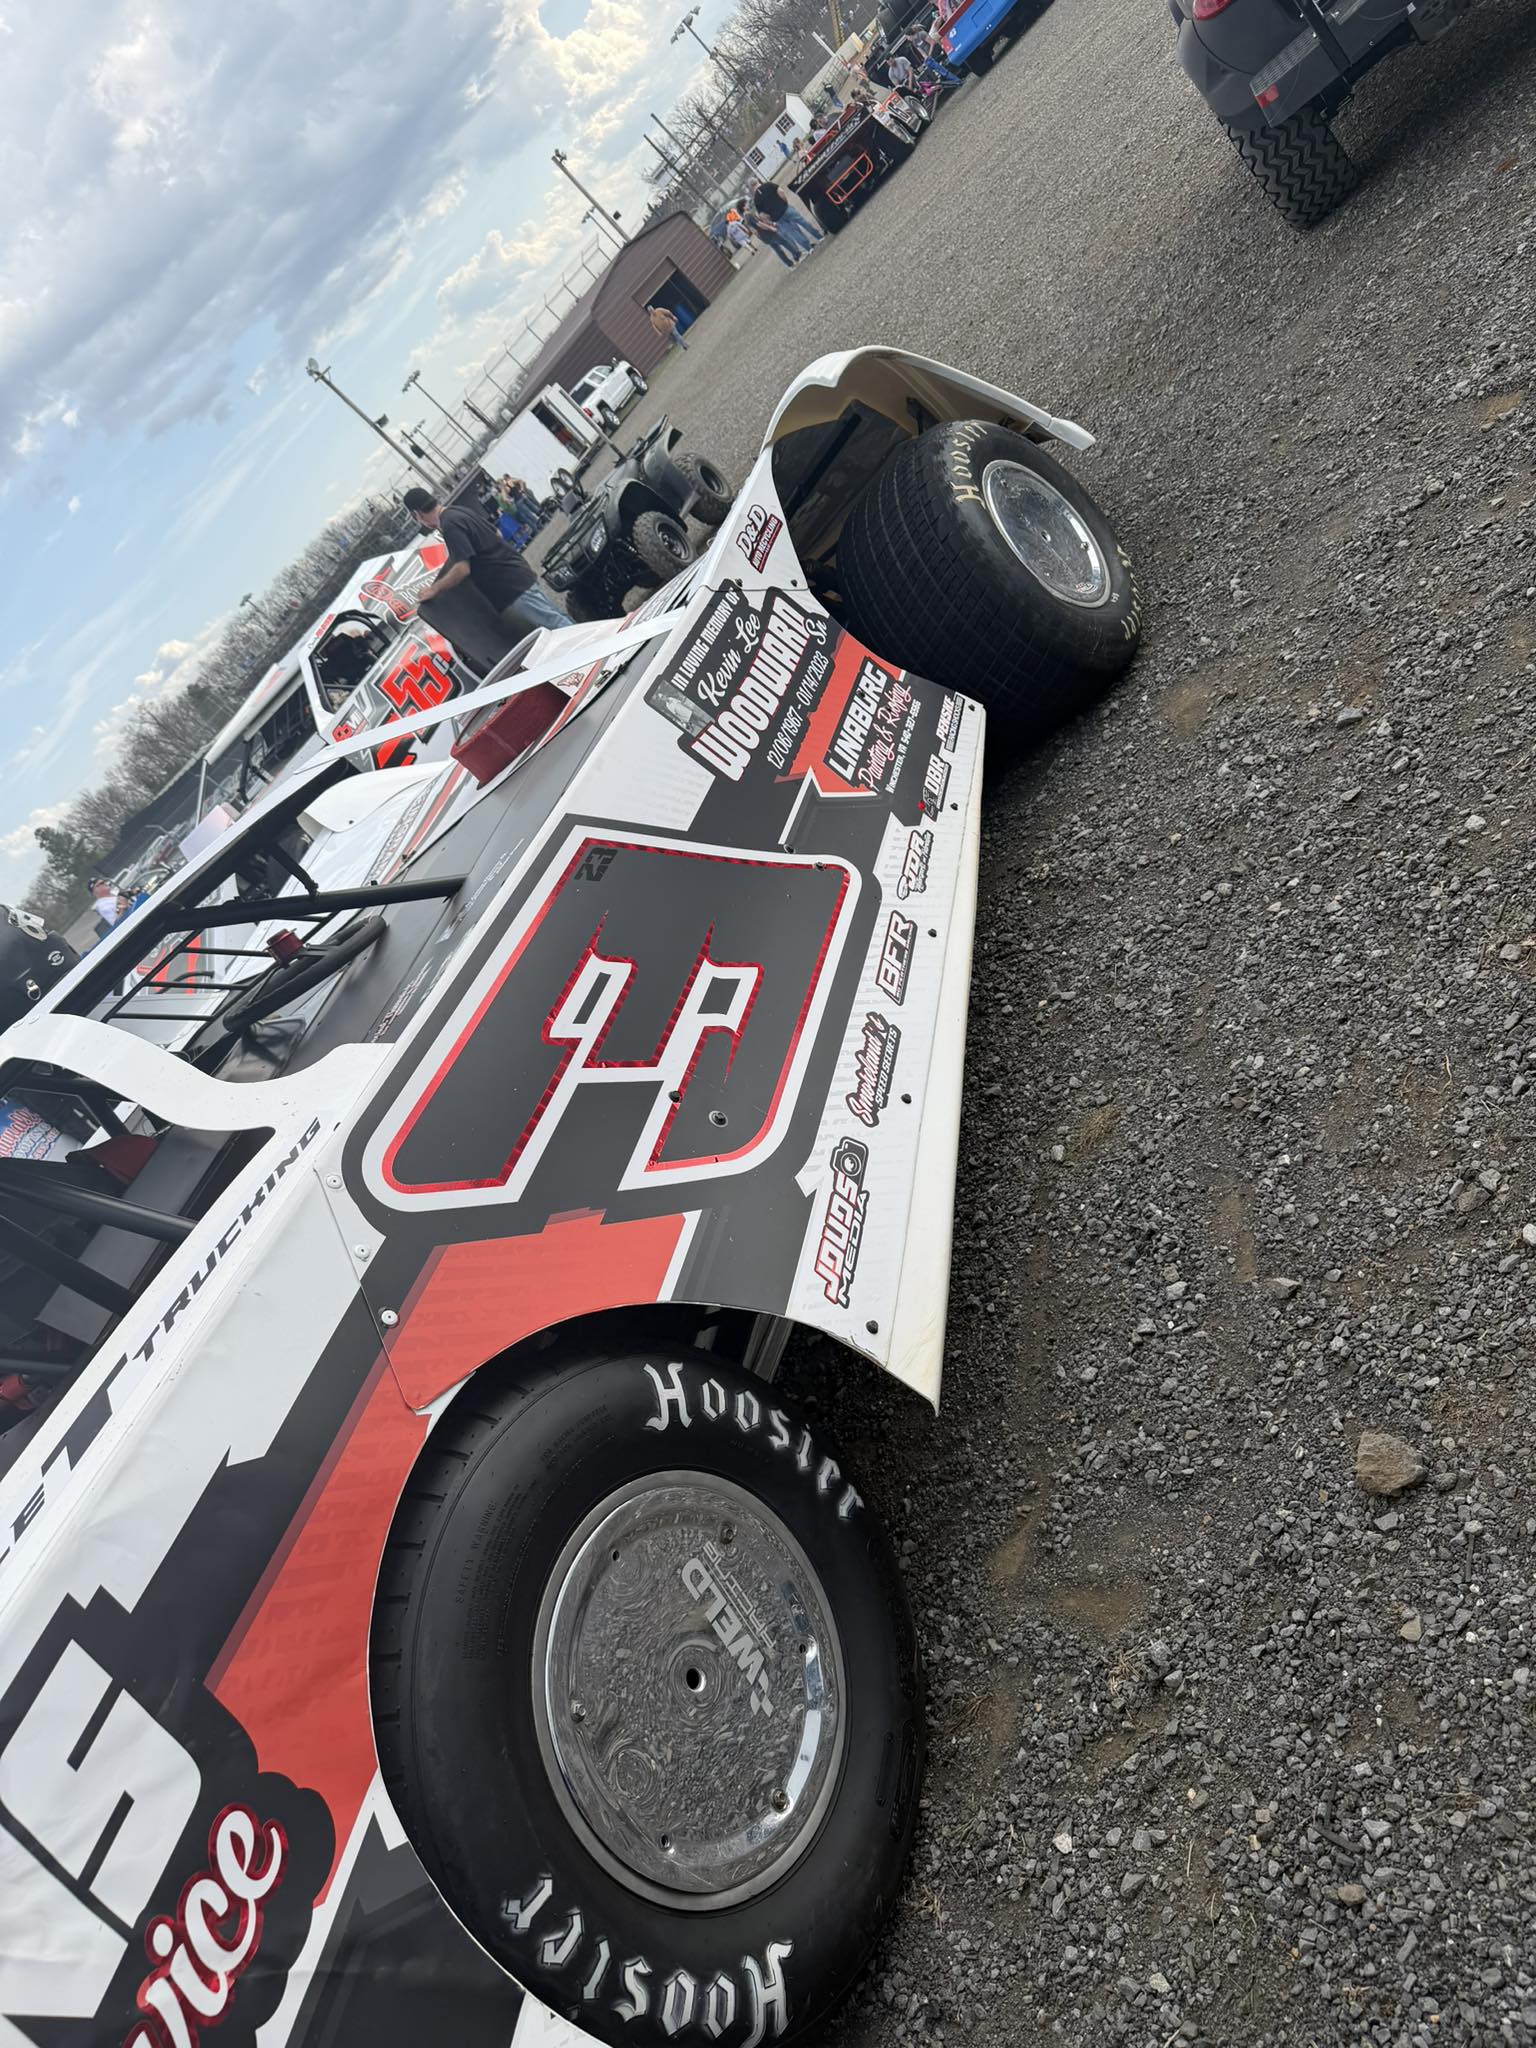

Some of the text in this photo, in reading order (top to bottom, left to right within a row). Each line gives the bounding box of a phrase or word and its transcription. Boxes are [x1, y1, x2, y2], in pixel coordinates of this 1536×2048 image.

[737, 505, 767, 558] D&D
[757, 516, 778, 554] RECYCLING
[671, 587, 741, 691] IN LOVING MEMORY OF
[697, 613, 760, 707] Kevin Lee
[805, 618, 828, 645] Sr
[690, 596, 811, 782] WOODWARD
[767, 705, 804, 770] 12/06/1967
[795, 650, 829, 706] 01/14/2023
[829, 661, 888, 781] LINABURG
[857, 682, 911, 791] Painting & Roofing
[936, 694, 955, 742] PENSKE
[924, 753, 945, 795] DBR
[878, 912, 913, 997] BFR
[362, 826, 862, 1211] 3
[875, 1027, 898, 1106] SPEED SECRETS
[132, 1115, 321, 1363] TRUCKING
[838, 1191, 868, 1306] MEDIA
[643, 1362, 866, 1521] Hoosier
[681, 1557, 765, 1685] WELD
[703, 1540, 776, 1648] RACING
[502, 1872, 795, 2048] Hoosier
